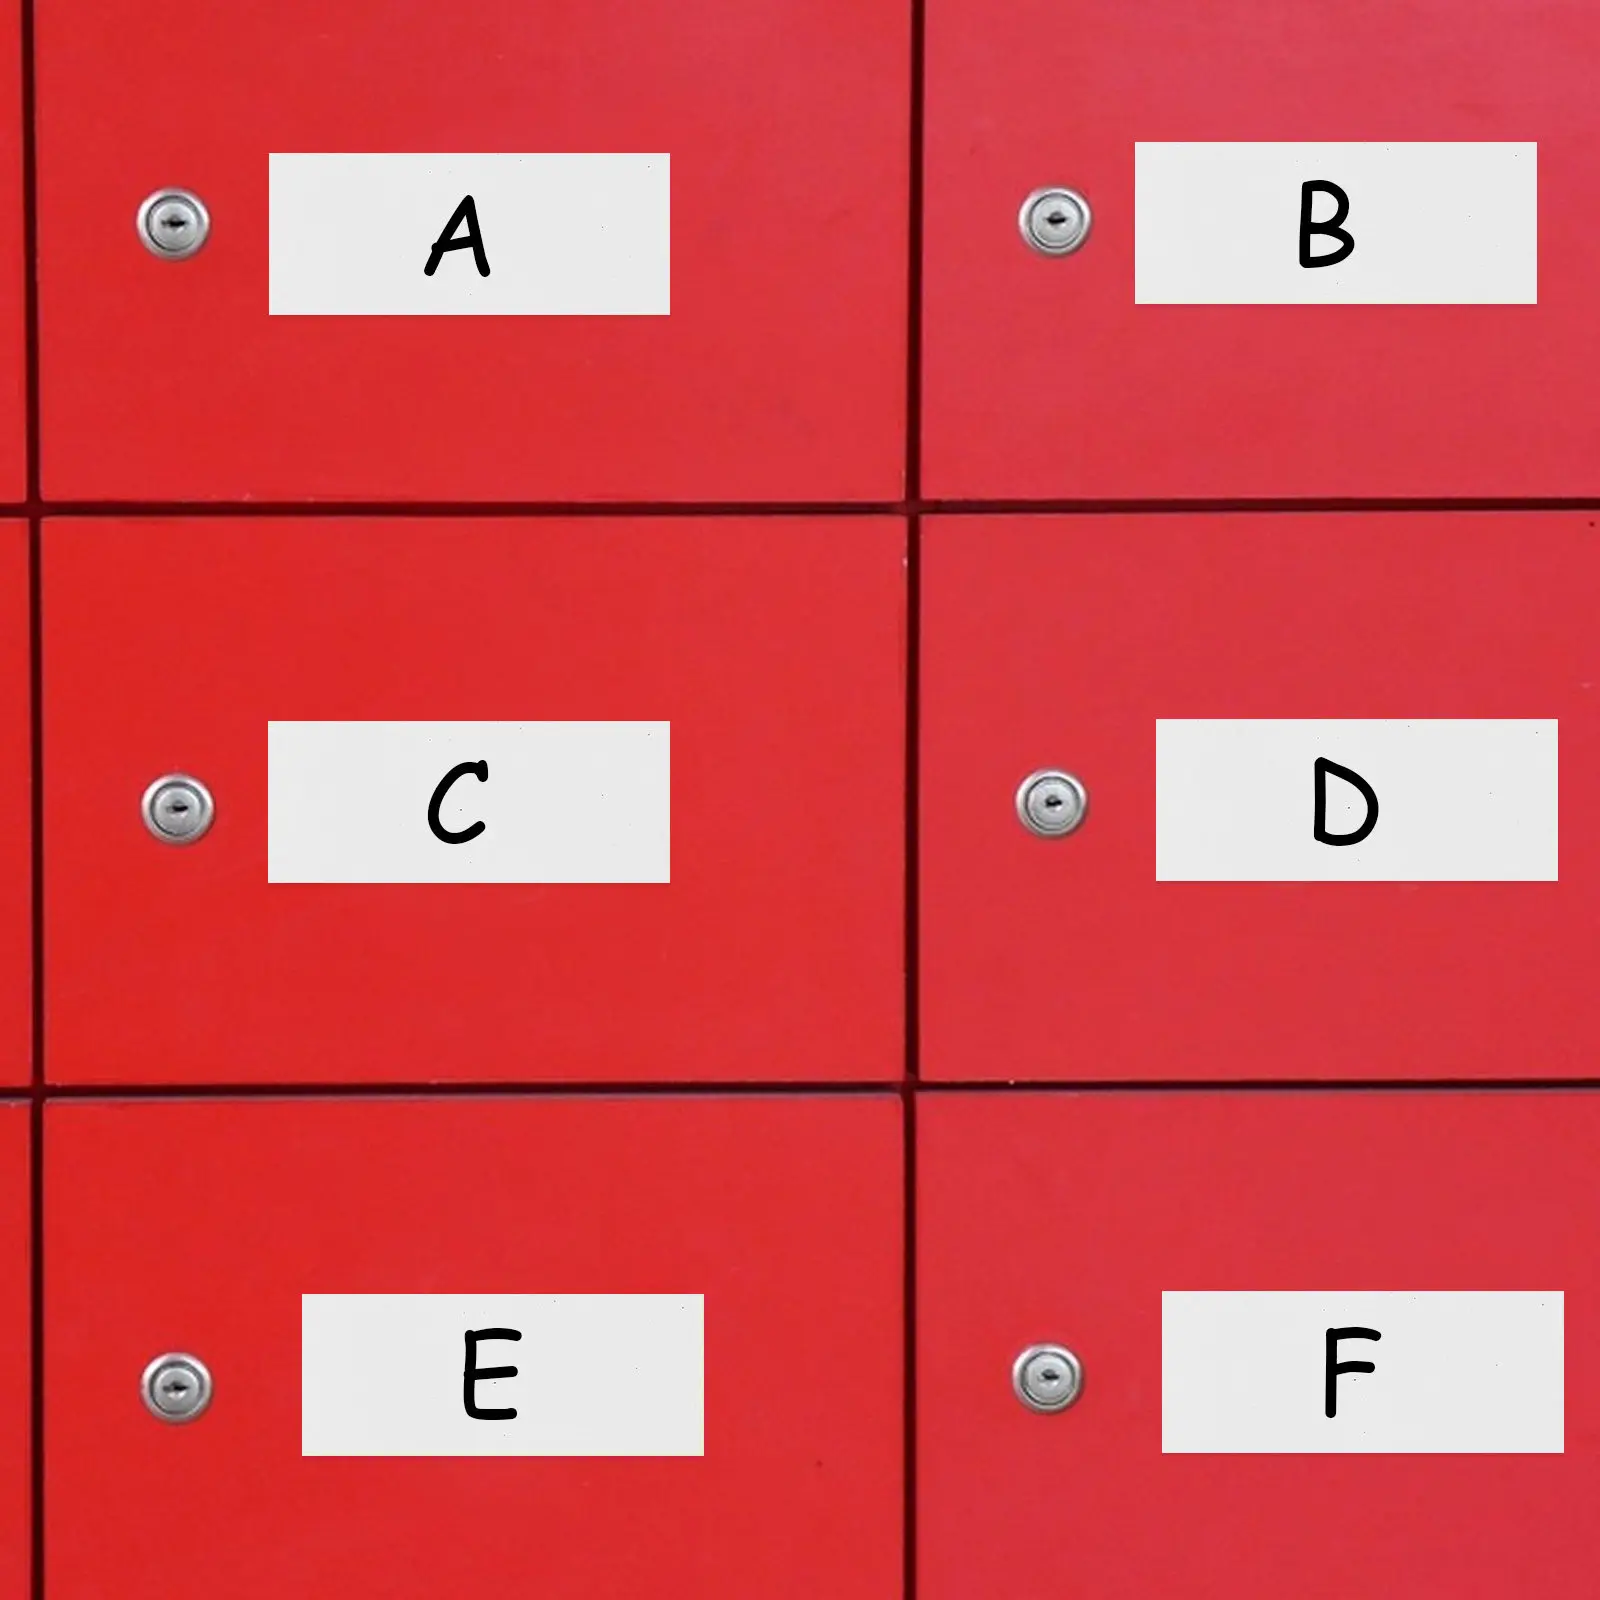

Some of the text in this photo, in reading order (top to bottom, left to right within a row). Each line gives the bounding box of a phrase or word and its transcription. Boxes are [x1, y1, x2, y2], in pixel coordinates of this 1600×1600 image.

[424, 195, 490, 277] A
[1299, 180, 1355, 268] B
[428, 760, 488, 844] C
[1314, 757, 1379, 846] D
[464, 1328, 522, 1420] E
[1325, 1327, 1381, 1418] F
